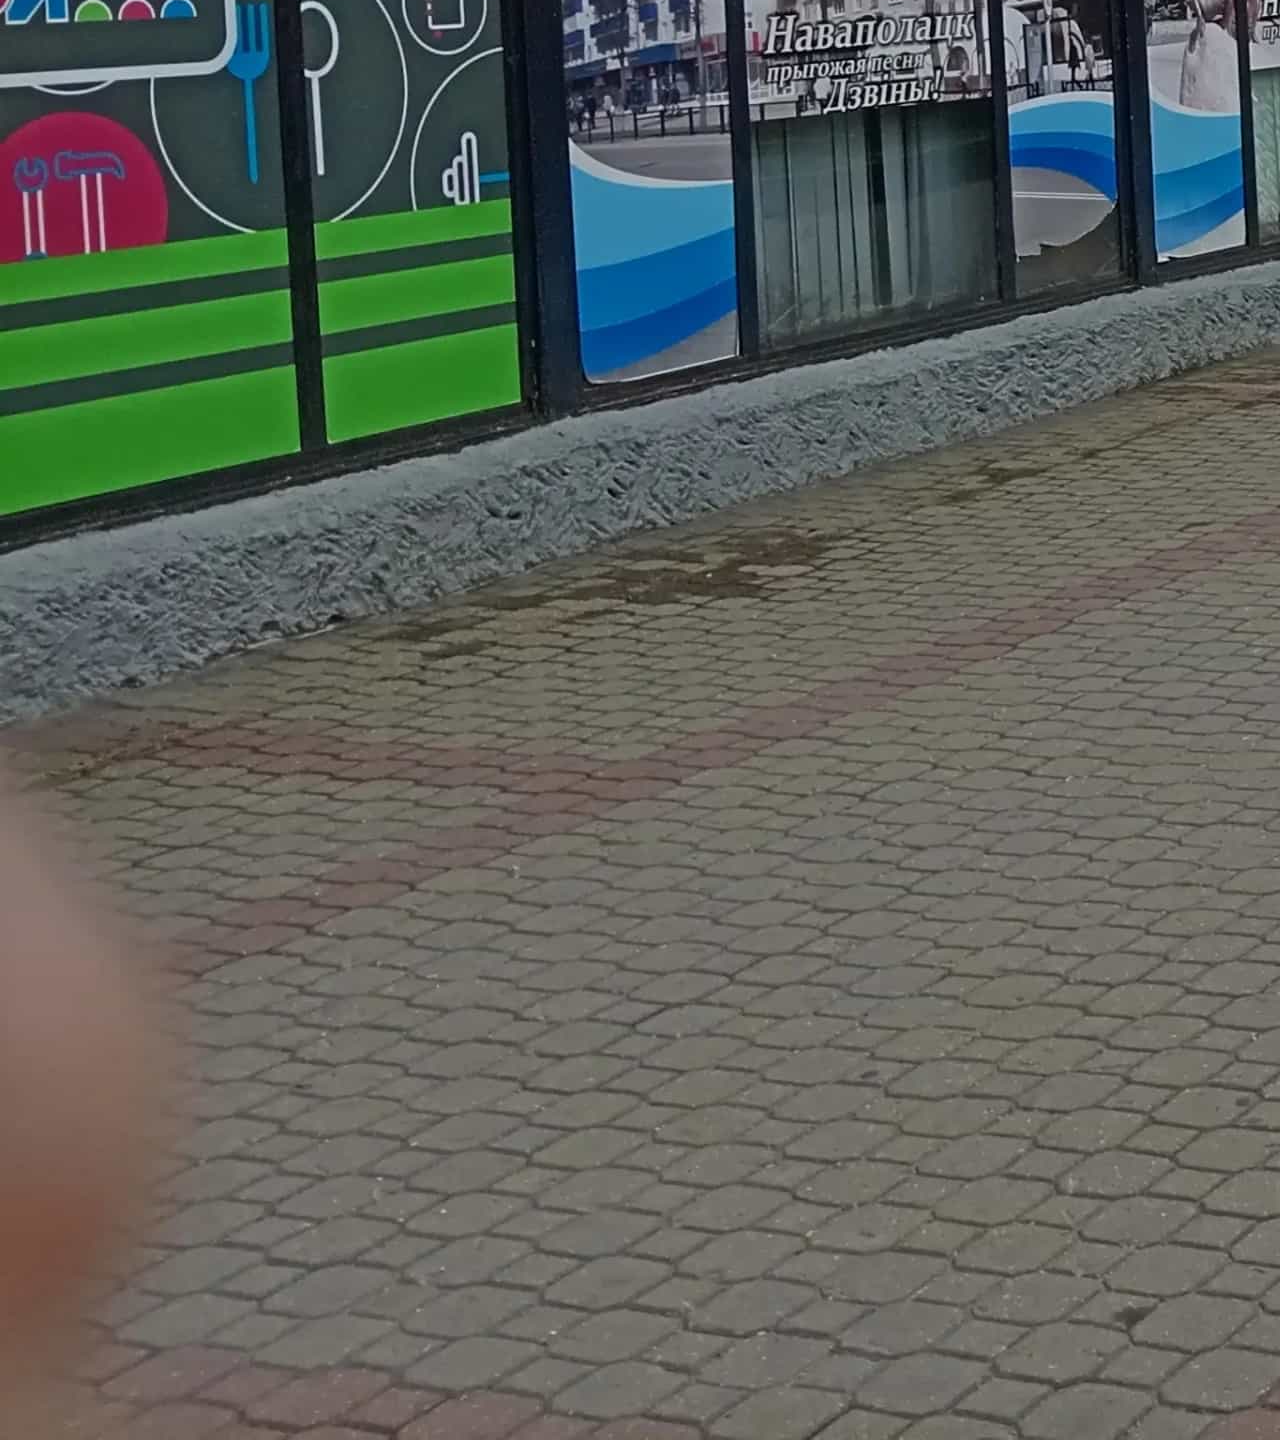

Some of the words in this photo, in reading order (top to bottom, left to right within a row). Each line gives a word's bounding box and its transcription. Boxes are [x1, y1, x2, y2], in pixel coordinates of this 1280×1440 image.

[764, 13, 975, 54] Наваполацк
[766, 58, 866, 87] прыгожая
[870, 53, 925, 73] песня
[823, 68, 943, 114] Дзвіны!
